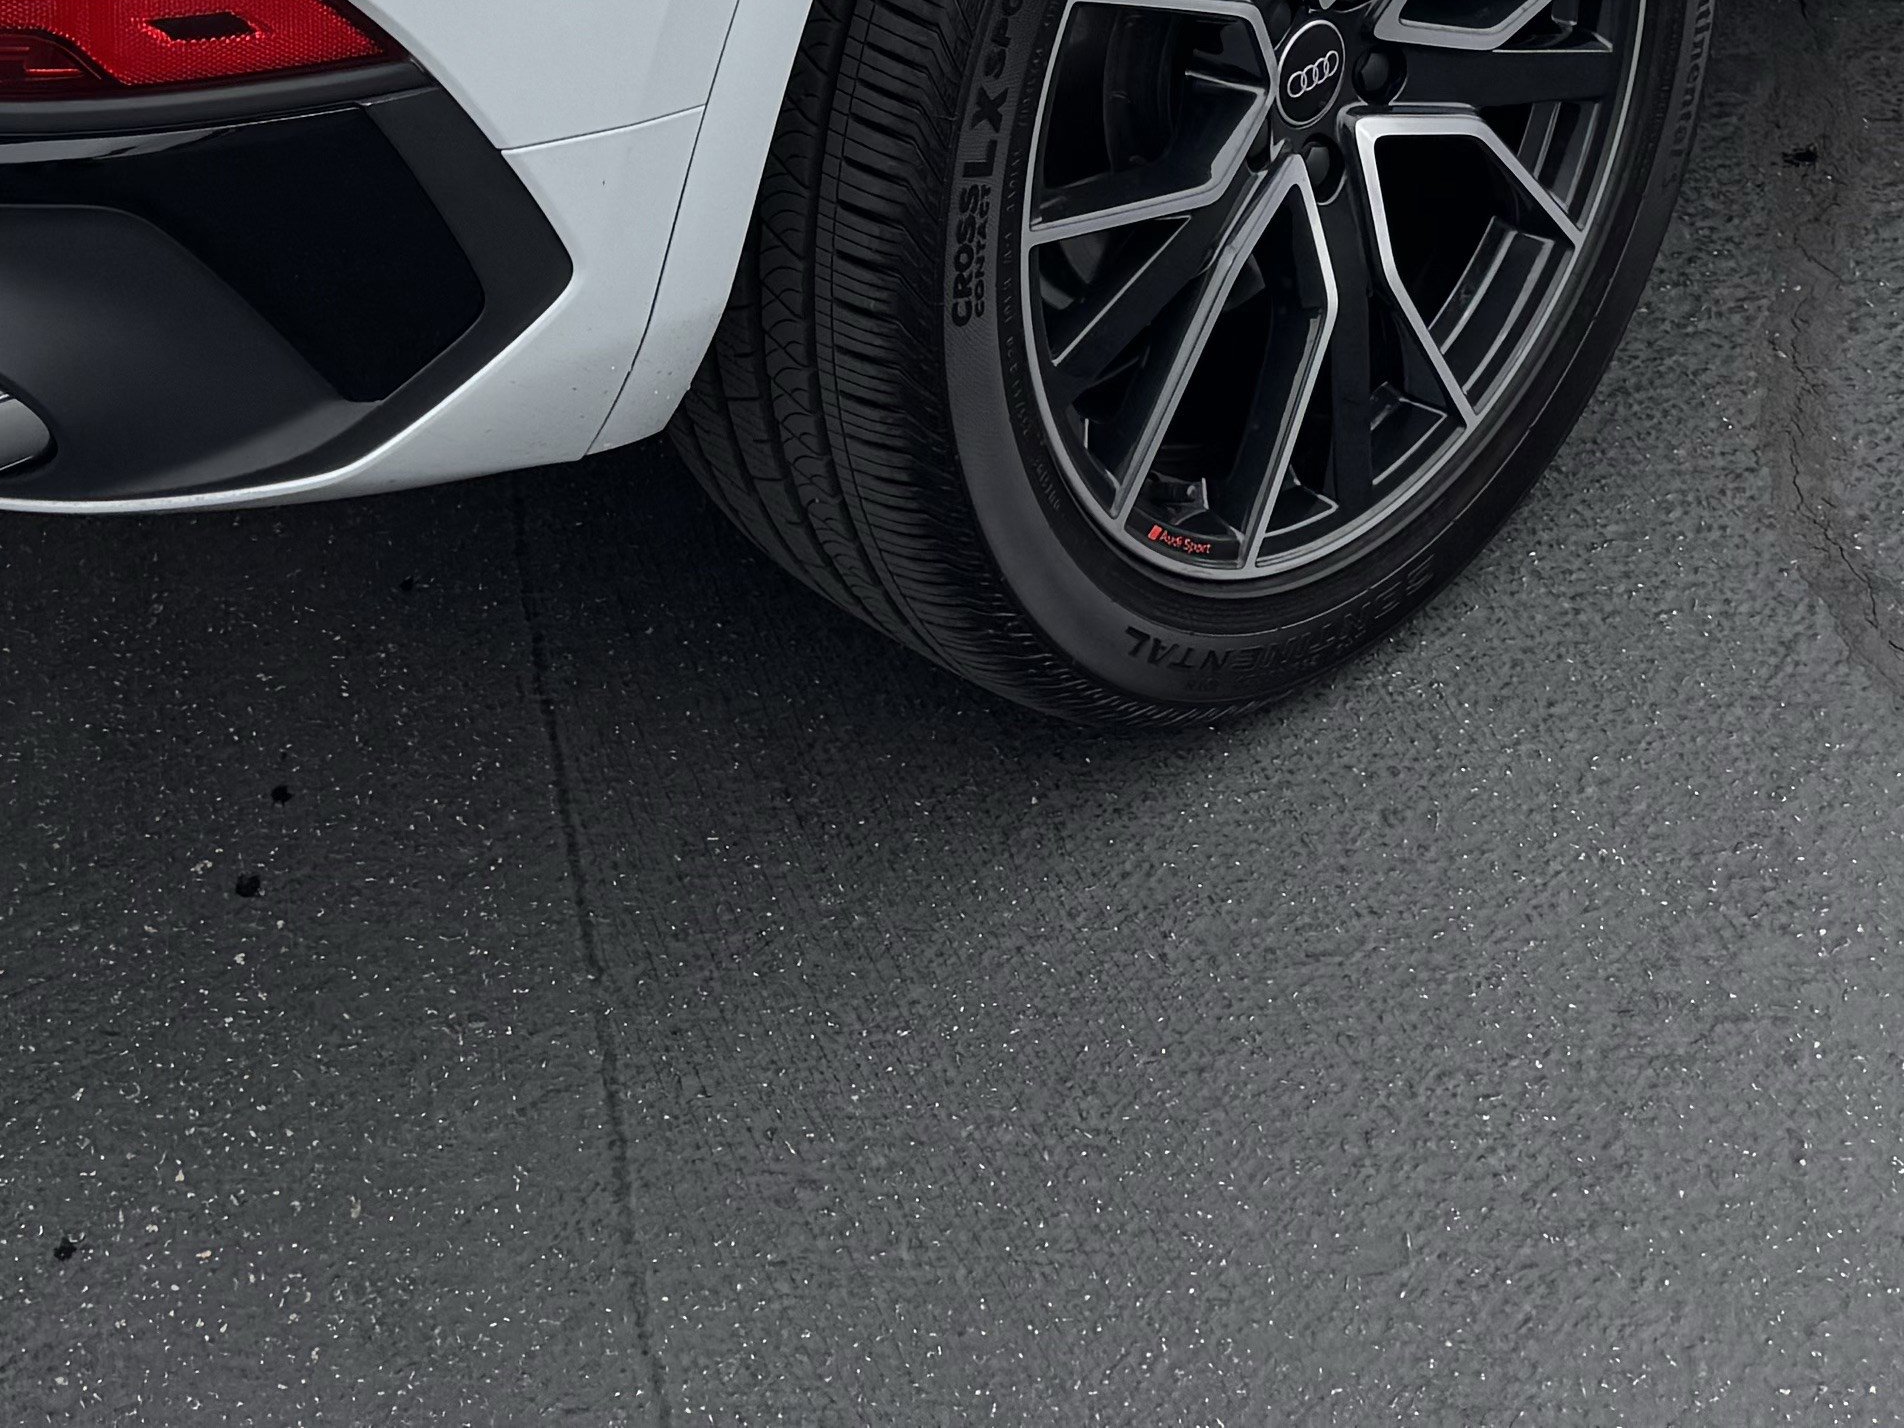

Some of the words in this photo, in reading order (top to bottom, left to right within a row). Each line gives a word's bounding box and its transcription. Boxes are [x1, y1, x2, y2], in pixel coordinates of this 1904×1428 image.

[962, 86, 1010, 179] LX
[951, 184, 981, 328] CROSS
[1183, 538, 1211, 554] Sport
